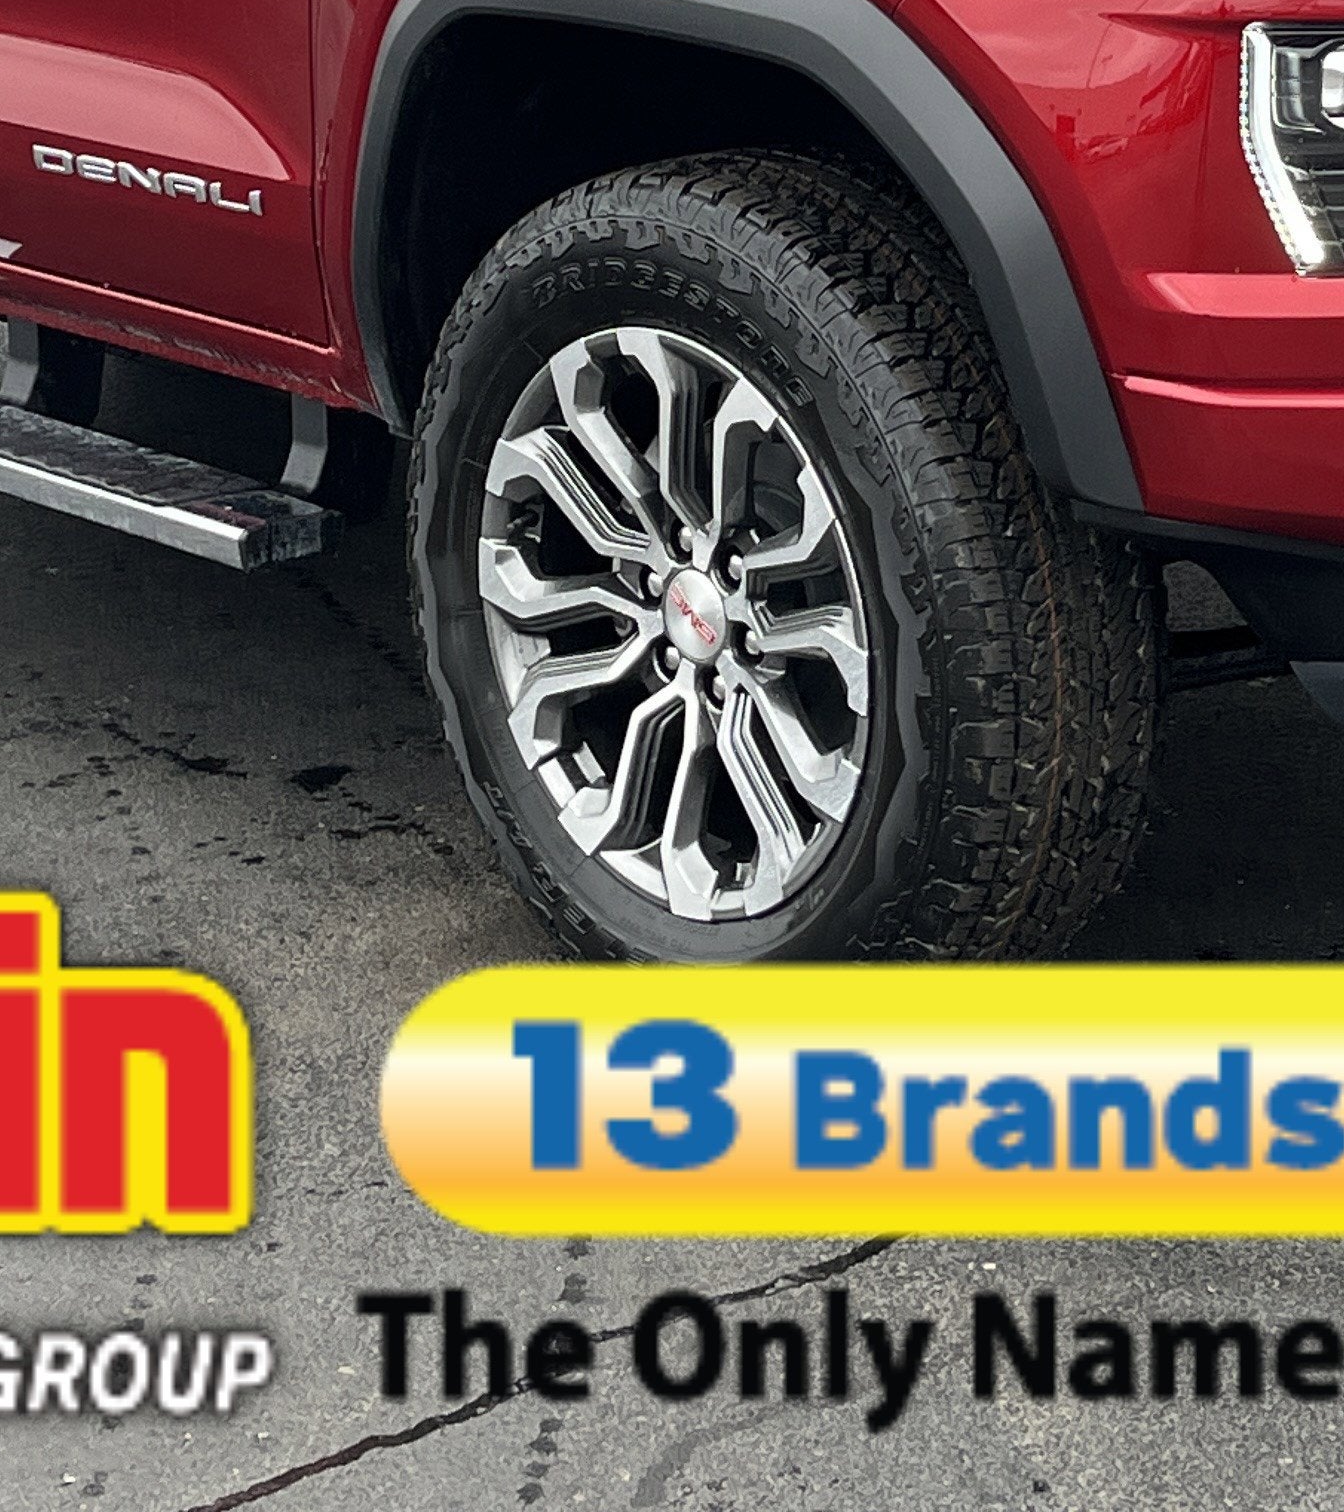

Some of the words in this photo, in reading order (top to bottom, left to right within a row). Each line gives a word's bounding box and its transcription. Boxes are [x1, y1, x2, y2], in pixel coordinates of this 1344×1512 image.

[31, 142, 264, 218] DENALI
[531, 255, 815, 408] BRIDGESTONE
[668, 581, 718, 646] GMC
